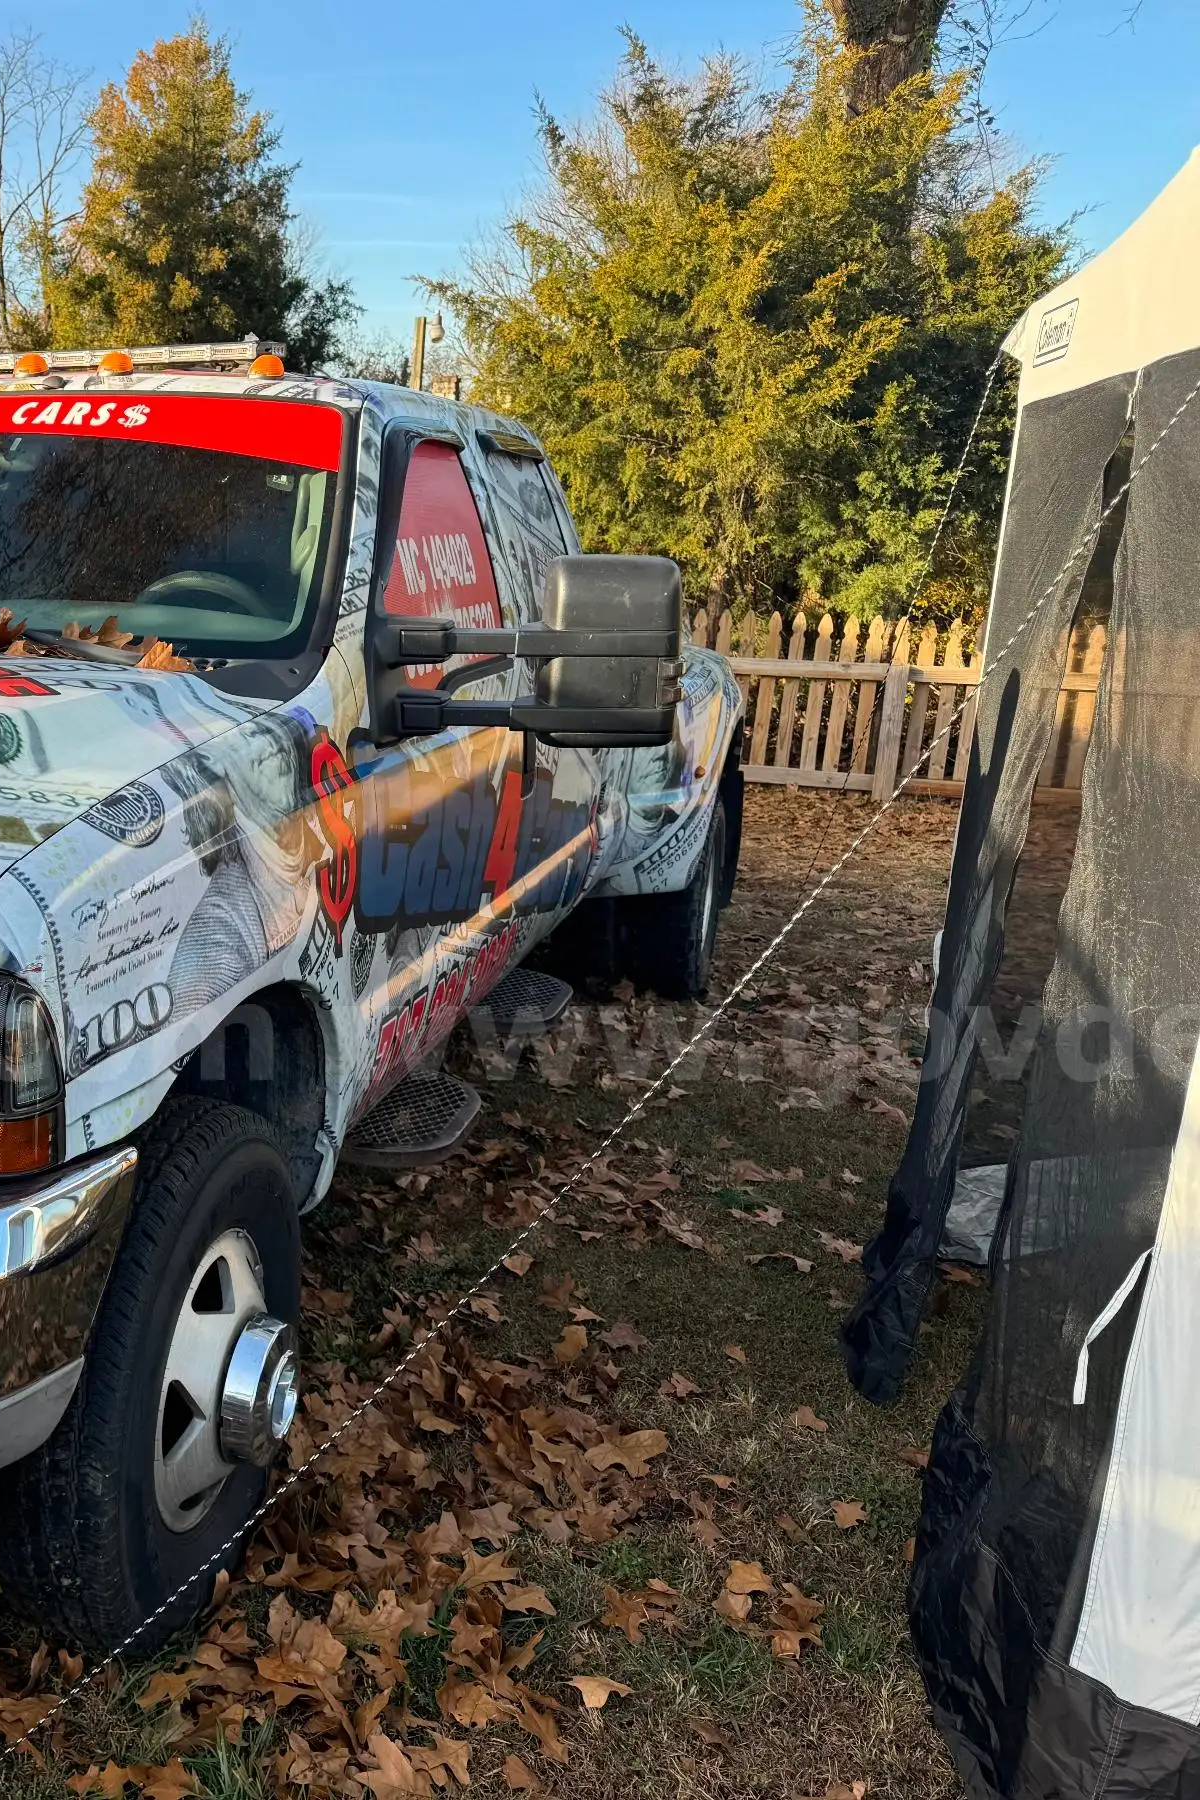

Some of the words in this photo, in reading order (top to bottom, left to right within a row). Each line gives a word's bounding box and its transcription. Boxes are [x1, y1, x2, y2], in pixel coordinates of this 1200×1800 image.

[11, 401, 152, 429] CARS$
[396, 537, 426, 595] MC
[422, 533, 477, 590] 1494029
[80, 981, 174, 1060] 100
